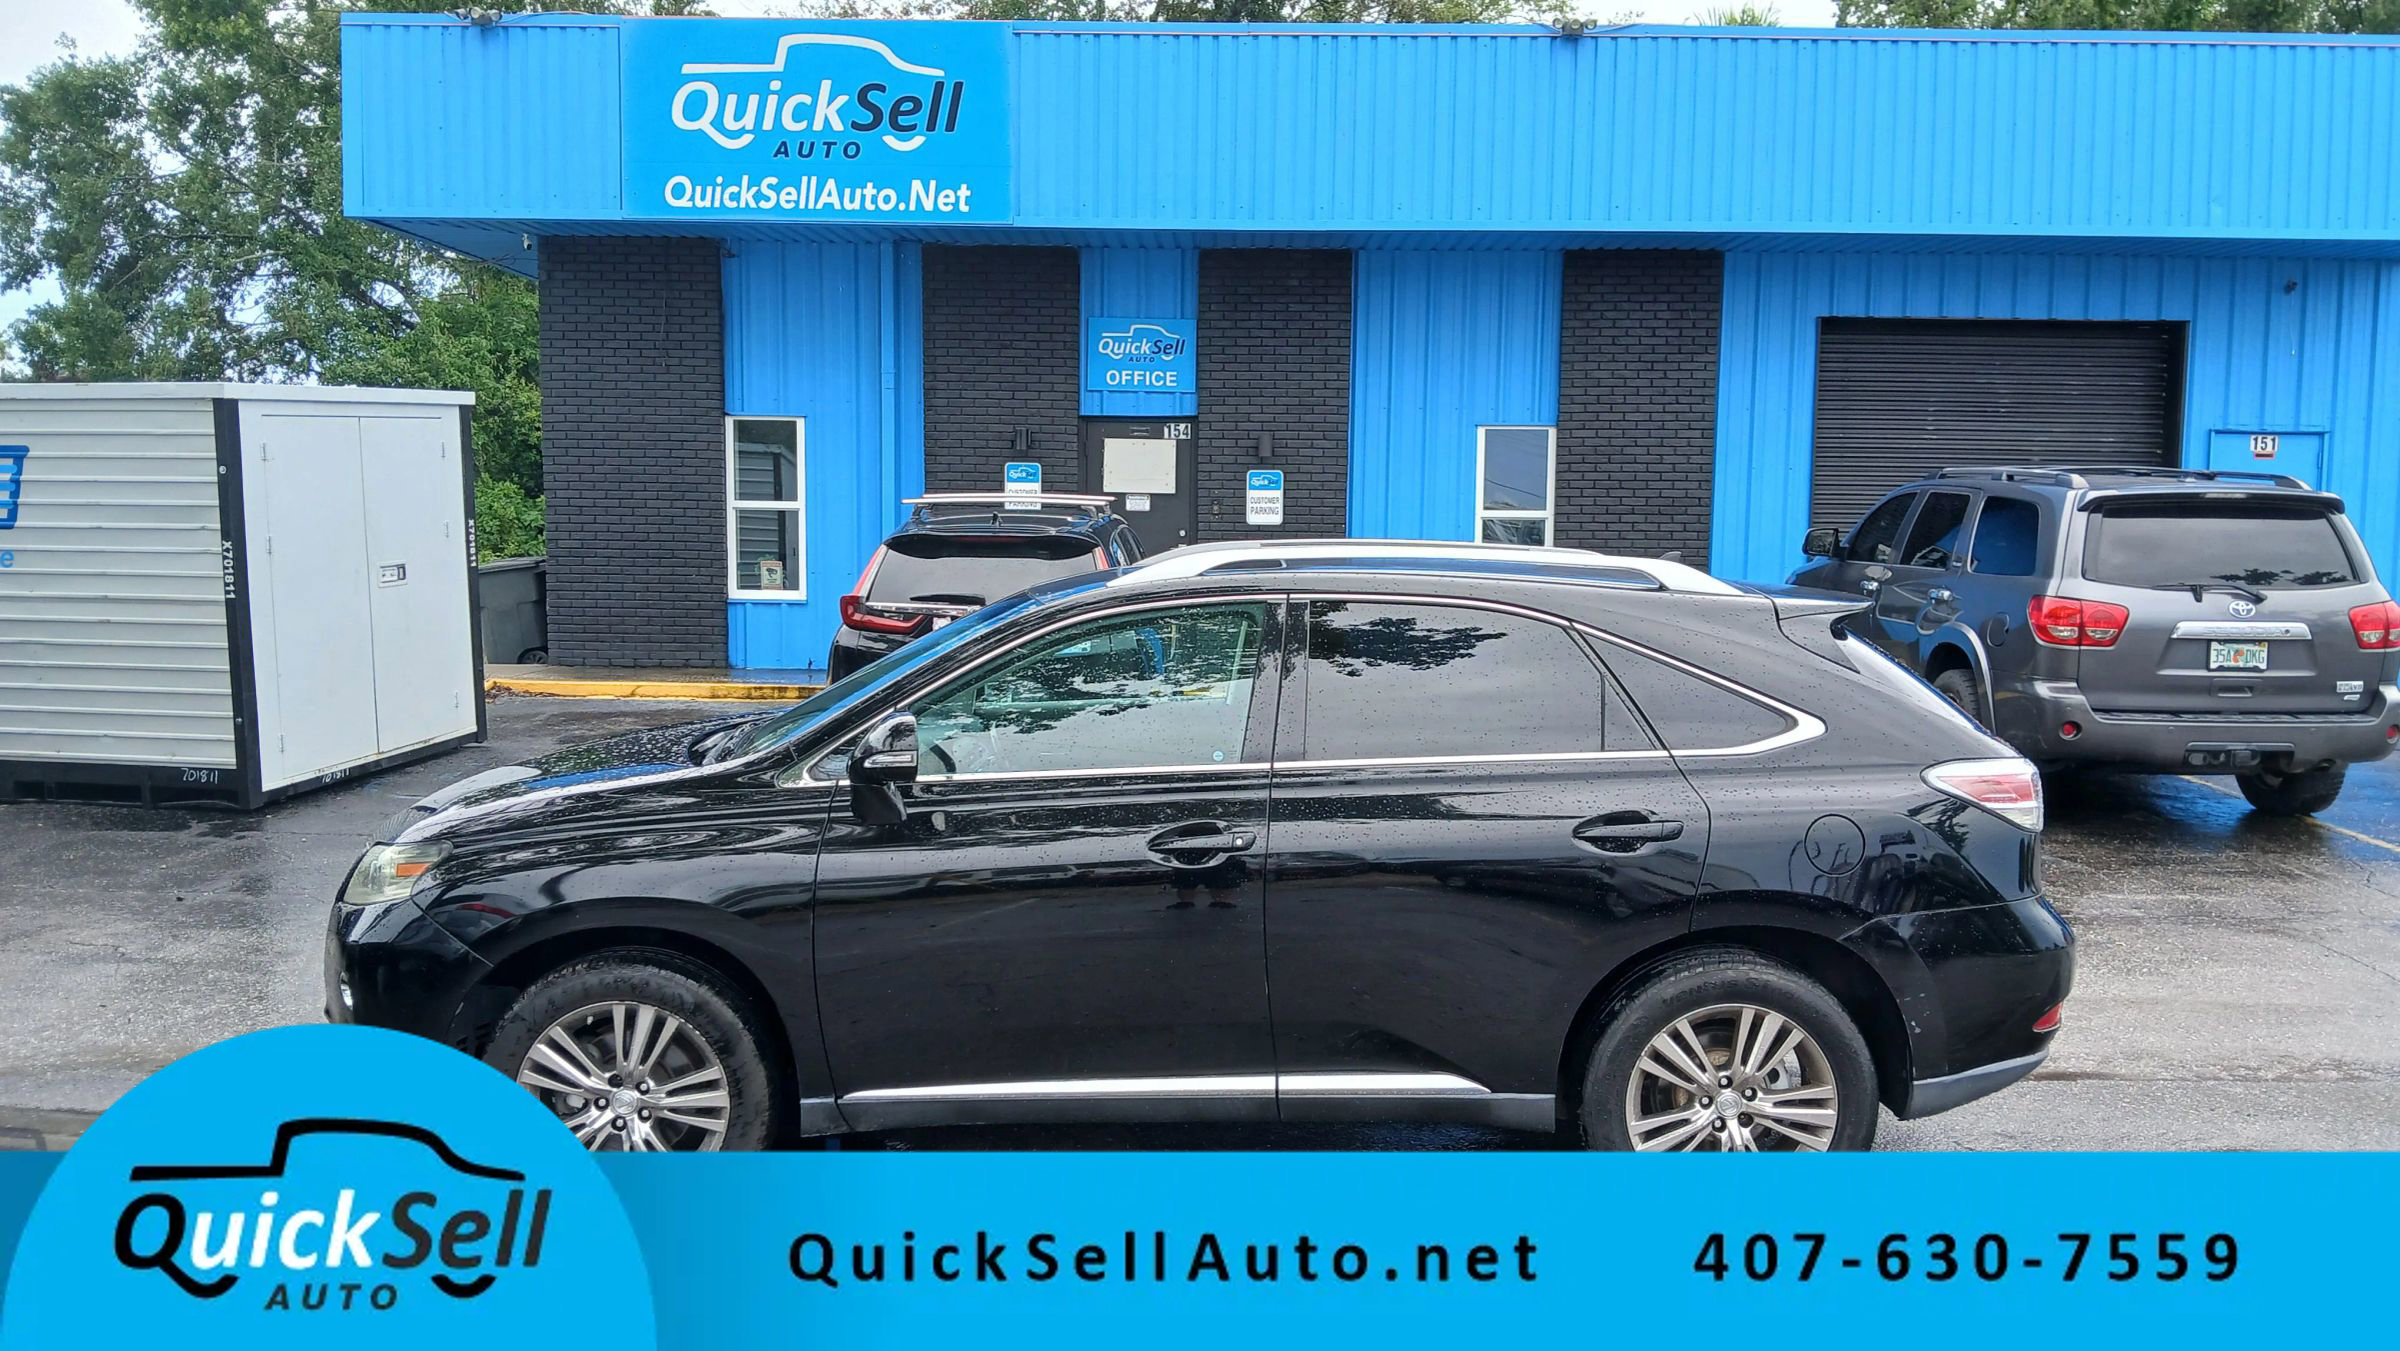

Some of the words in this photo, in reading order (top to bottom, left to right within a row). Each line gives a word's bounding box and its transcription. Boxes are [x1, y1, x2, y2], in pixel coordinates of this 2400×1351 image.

[670, 79, 964, 150] QuickSell
[773, 140, 862, 160] AUTO
[663, 174, 972, 213] QuickSellAuto.Net
[1098, 337, 1185, 359] QuickSell
[1106, 370, 1177, 386] OFFICE
[1163, 423, 1190, 438] 154
[2252, 435, 2276, 451] 151
[1250, 496, 1280, 504] CUSTOMER
[1250, 506, 1279, 515] PARKING
[468, 518, 477, 567] X701811
[222, 540, 236, 599] X701811
[2212, 648, 2232, 663] 35A
[2245, 649, 2265, 664] DKG
[181, 768, 218, 784] 701811
